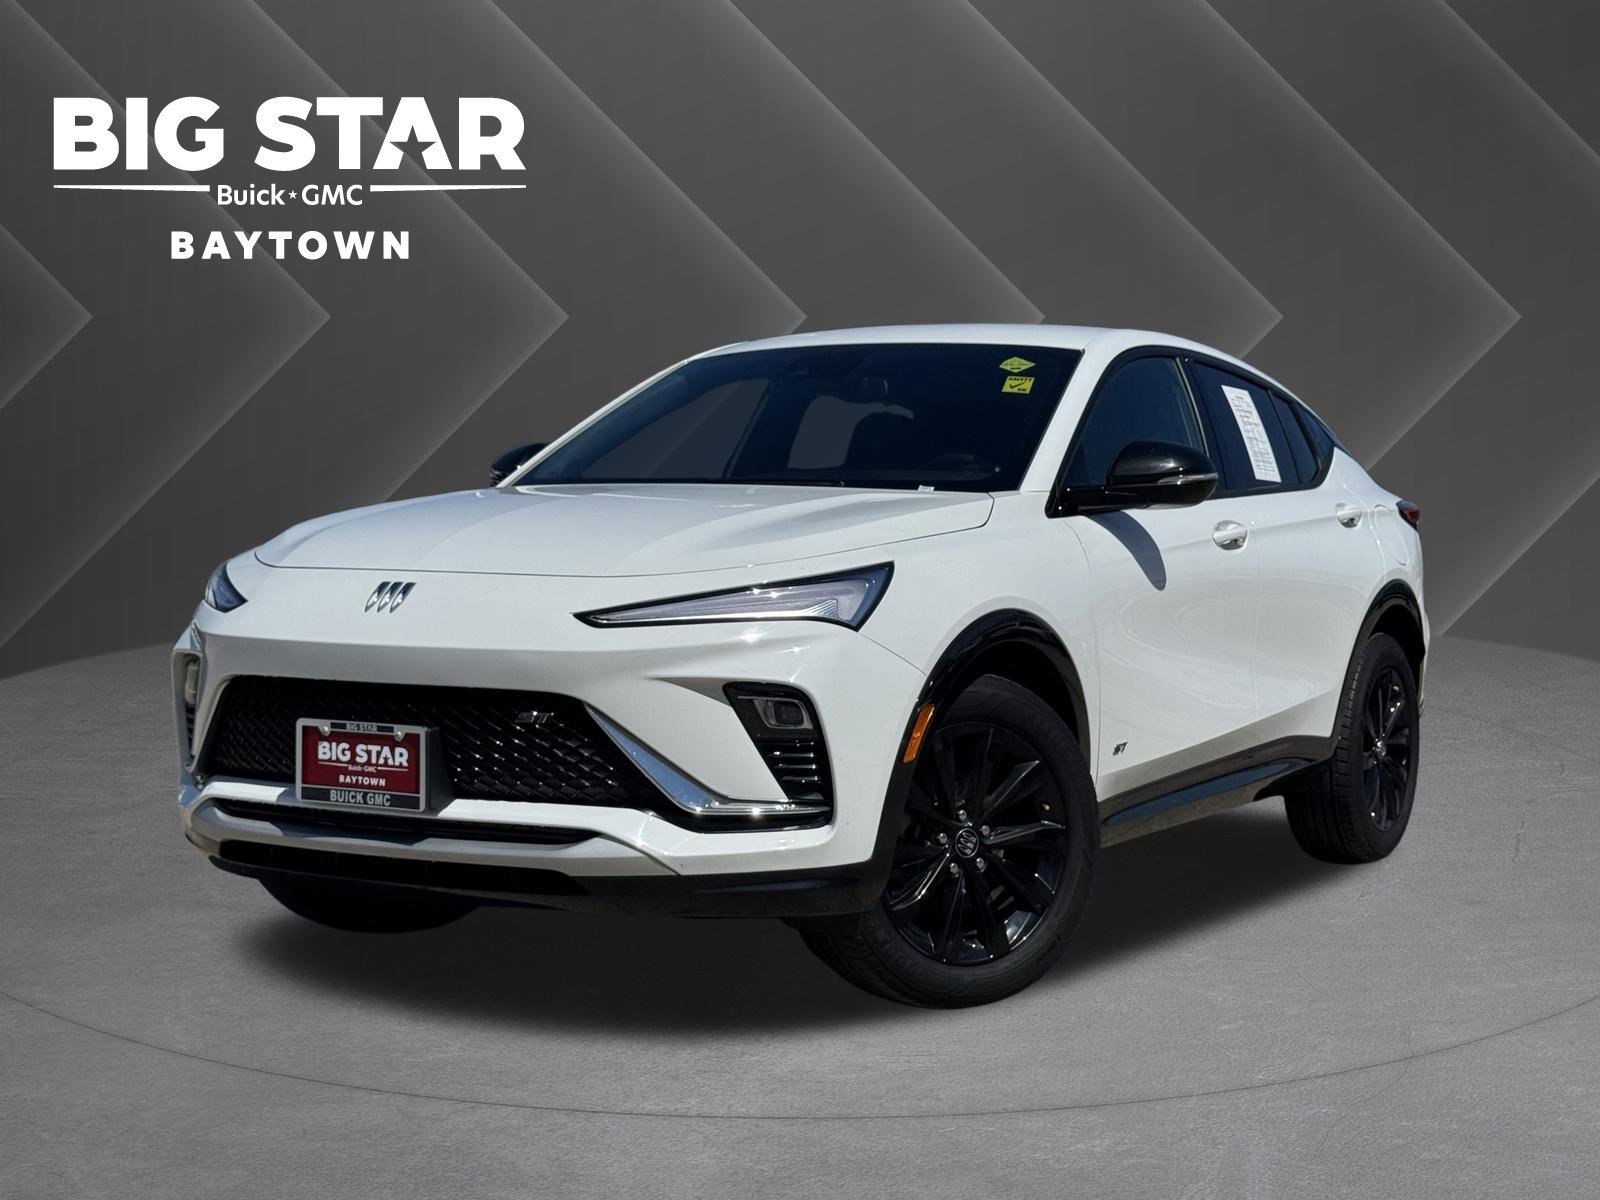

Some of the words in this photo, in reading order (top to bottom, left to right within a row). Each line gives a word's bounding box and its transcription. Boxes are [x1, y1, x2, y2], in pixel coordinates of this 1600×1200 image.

[346, 722, 359, 731] BIG
[359, 723, 378, 732] STAR
[317, 741, 351, 762] BIG
[355, 743, 409, 767] STAR
[338, 774, 386, 787] BAYTOWN
[329, 789, 365, 804] BUICK
[366, 791, 392, 807] GMC
